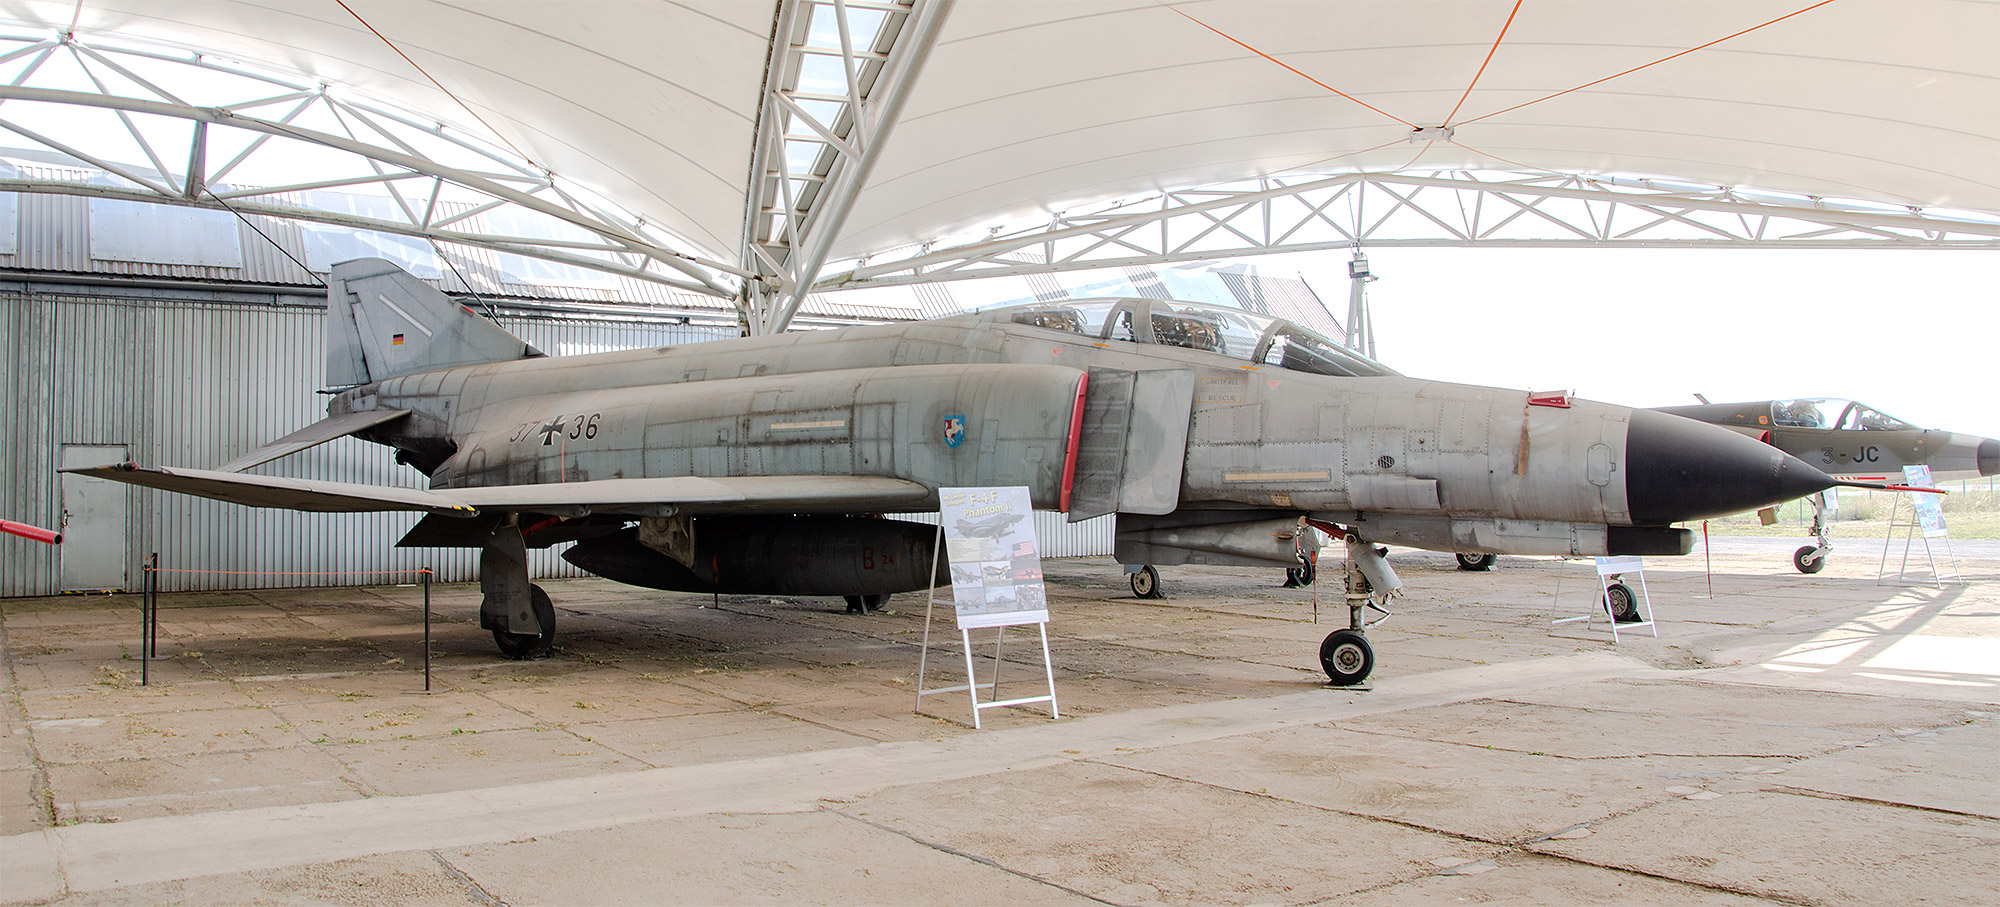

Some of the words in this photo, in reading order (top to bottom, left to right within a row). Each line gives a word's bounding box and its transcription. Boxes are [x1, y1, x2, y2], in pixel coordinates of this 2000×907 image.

[1208, 394, 1237, 402] RESCUE
[509, 420, 541, 443] 37
[569, 412, 602, 441] 36
[1821, 447, 1835, 465] 3
[1852, 445, 1880, 463] JC
[964, 505, 1003, 518] Phantom
[862, 547, 875, 570] B
